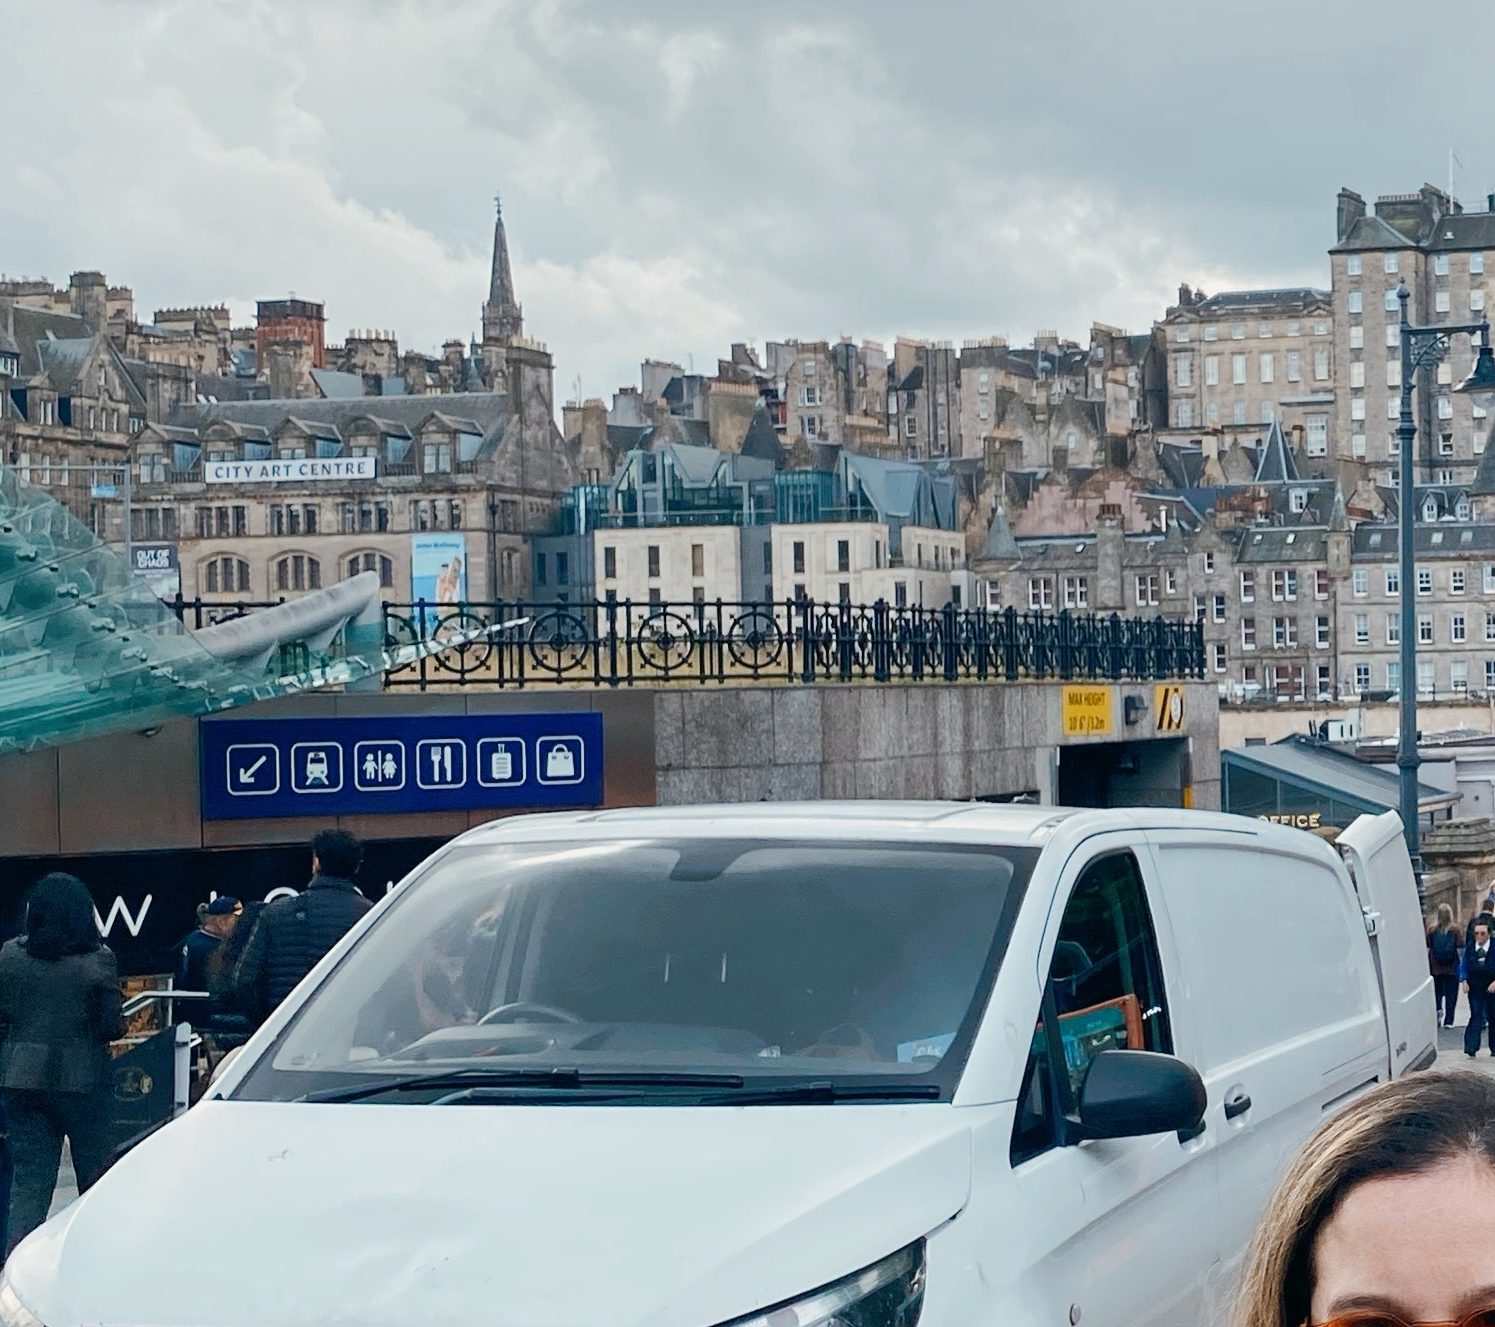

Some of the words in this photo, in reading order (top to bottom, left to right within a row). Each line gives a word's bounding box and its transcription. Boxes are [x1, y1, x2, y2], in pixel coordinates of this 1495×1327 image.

[215, 465, 253, 479] CITY
[260, 464, 293, 478] ART
[298, 461, 365, 476] CENTRE
[136, 550, 156, 560] OUT
[156, 549, 170, 559] OF
